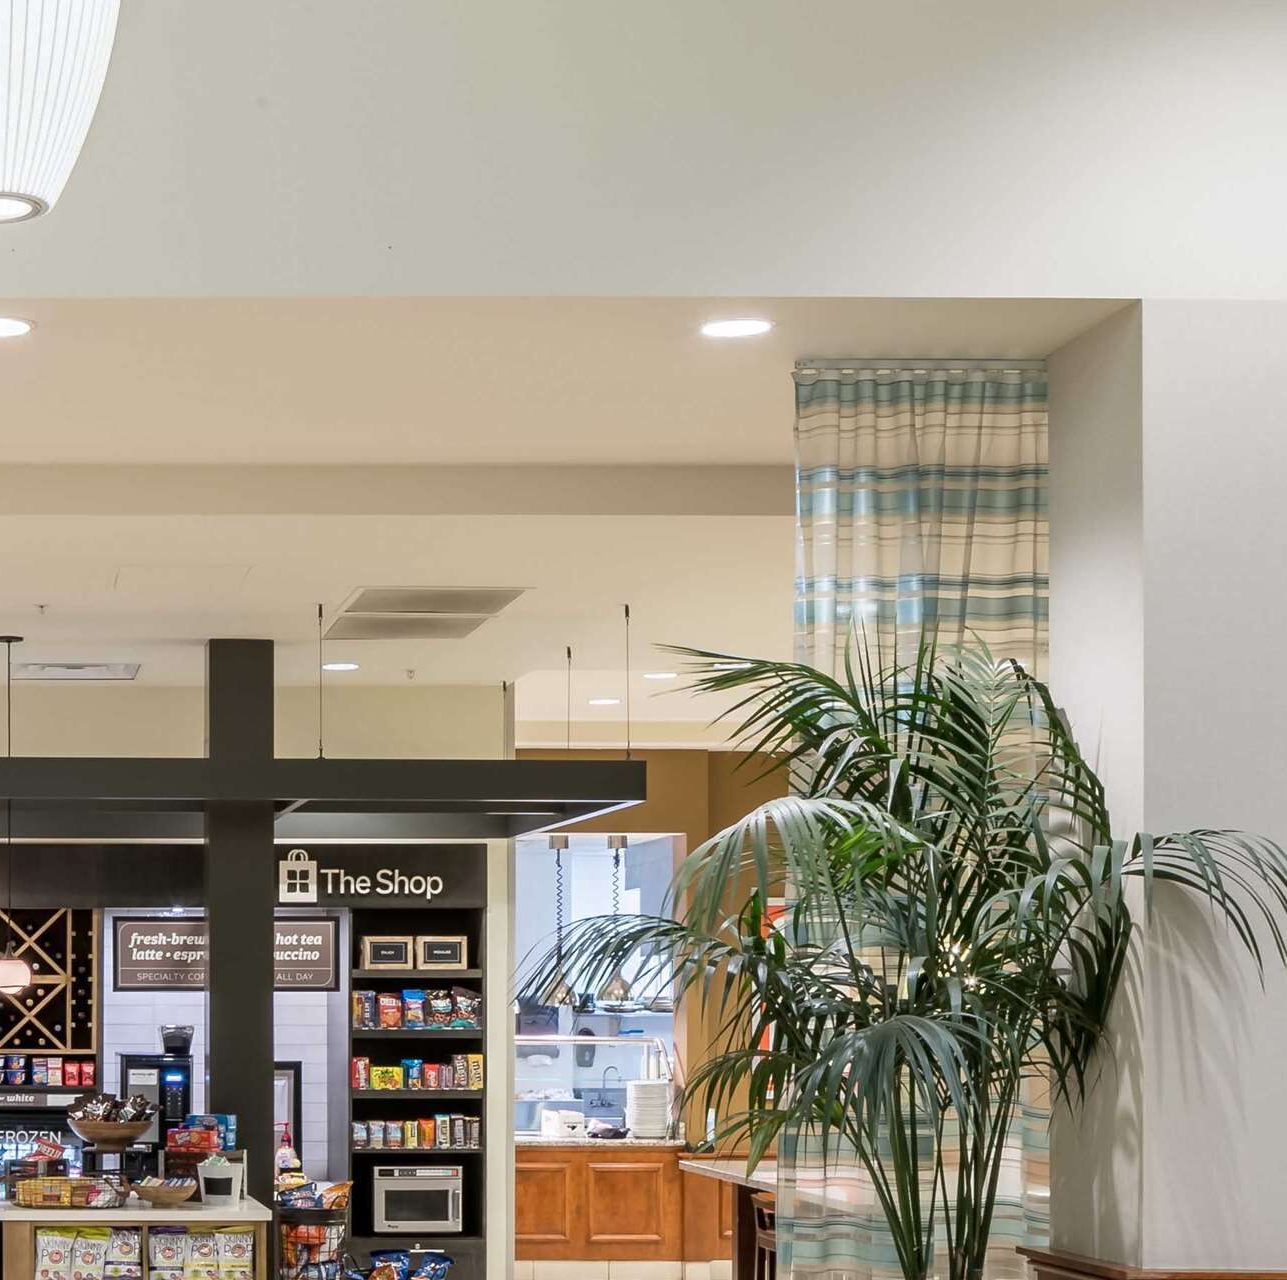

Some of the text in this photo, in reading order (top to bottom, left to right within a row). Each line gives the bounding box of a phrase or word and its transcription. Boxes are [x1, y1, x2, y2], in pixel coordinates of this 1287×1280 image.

[320, 869, 443, 899] The Shop
[275, 933, 296, 945] hot
[300, 935, 322, 945] tea
[132, 948, 163, 960] latte
[137, 972, 185, 980] SPECIALTY
[276, 972, 292, 981] ALL
[296, 972, 313, 981] DAY
[7, 1094, 35, 1102] white
